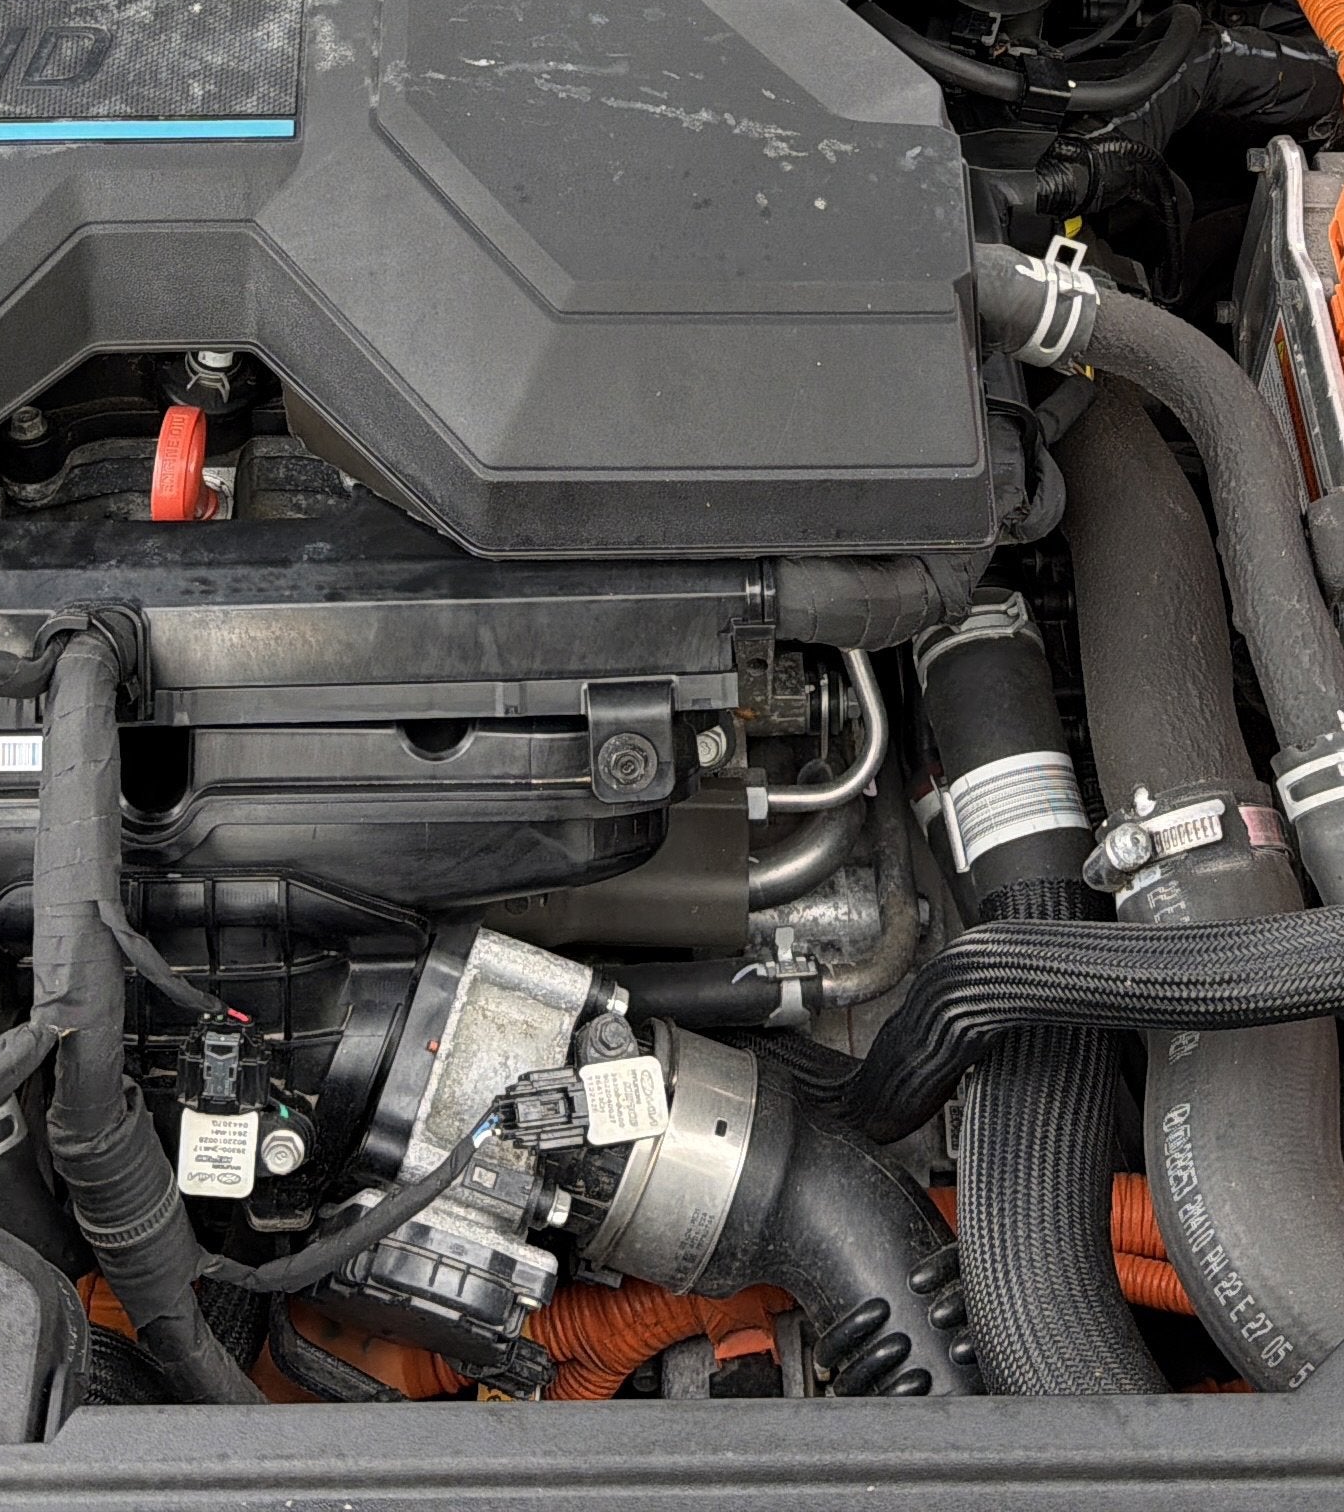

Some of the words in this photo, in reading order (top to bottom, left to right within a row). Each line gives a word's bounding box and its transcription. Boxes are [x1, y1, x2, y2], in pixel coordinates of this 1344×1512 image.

[1199, 1244, 1230, 1281] PH
[1212, 1270, 1246, 1307] 22
[1227, 1294, 1257, 1323] E
[1239, 1312, 1275, 1344] 27
[1259, 1335, 1294, 1369] 05
